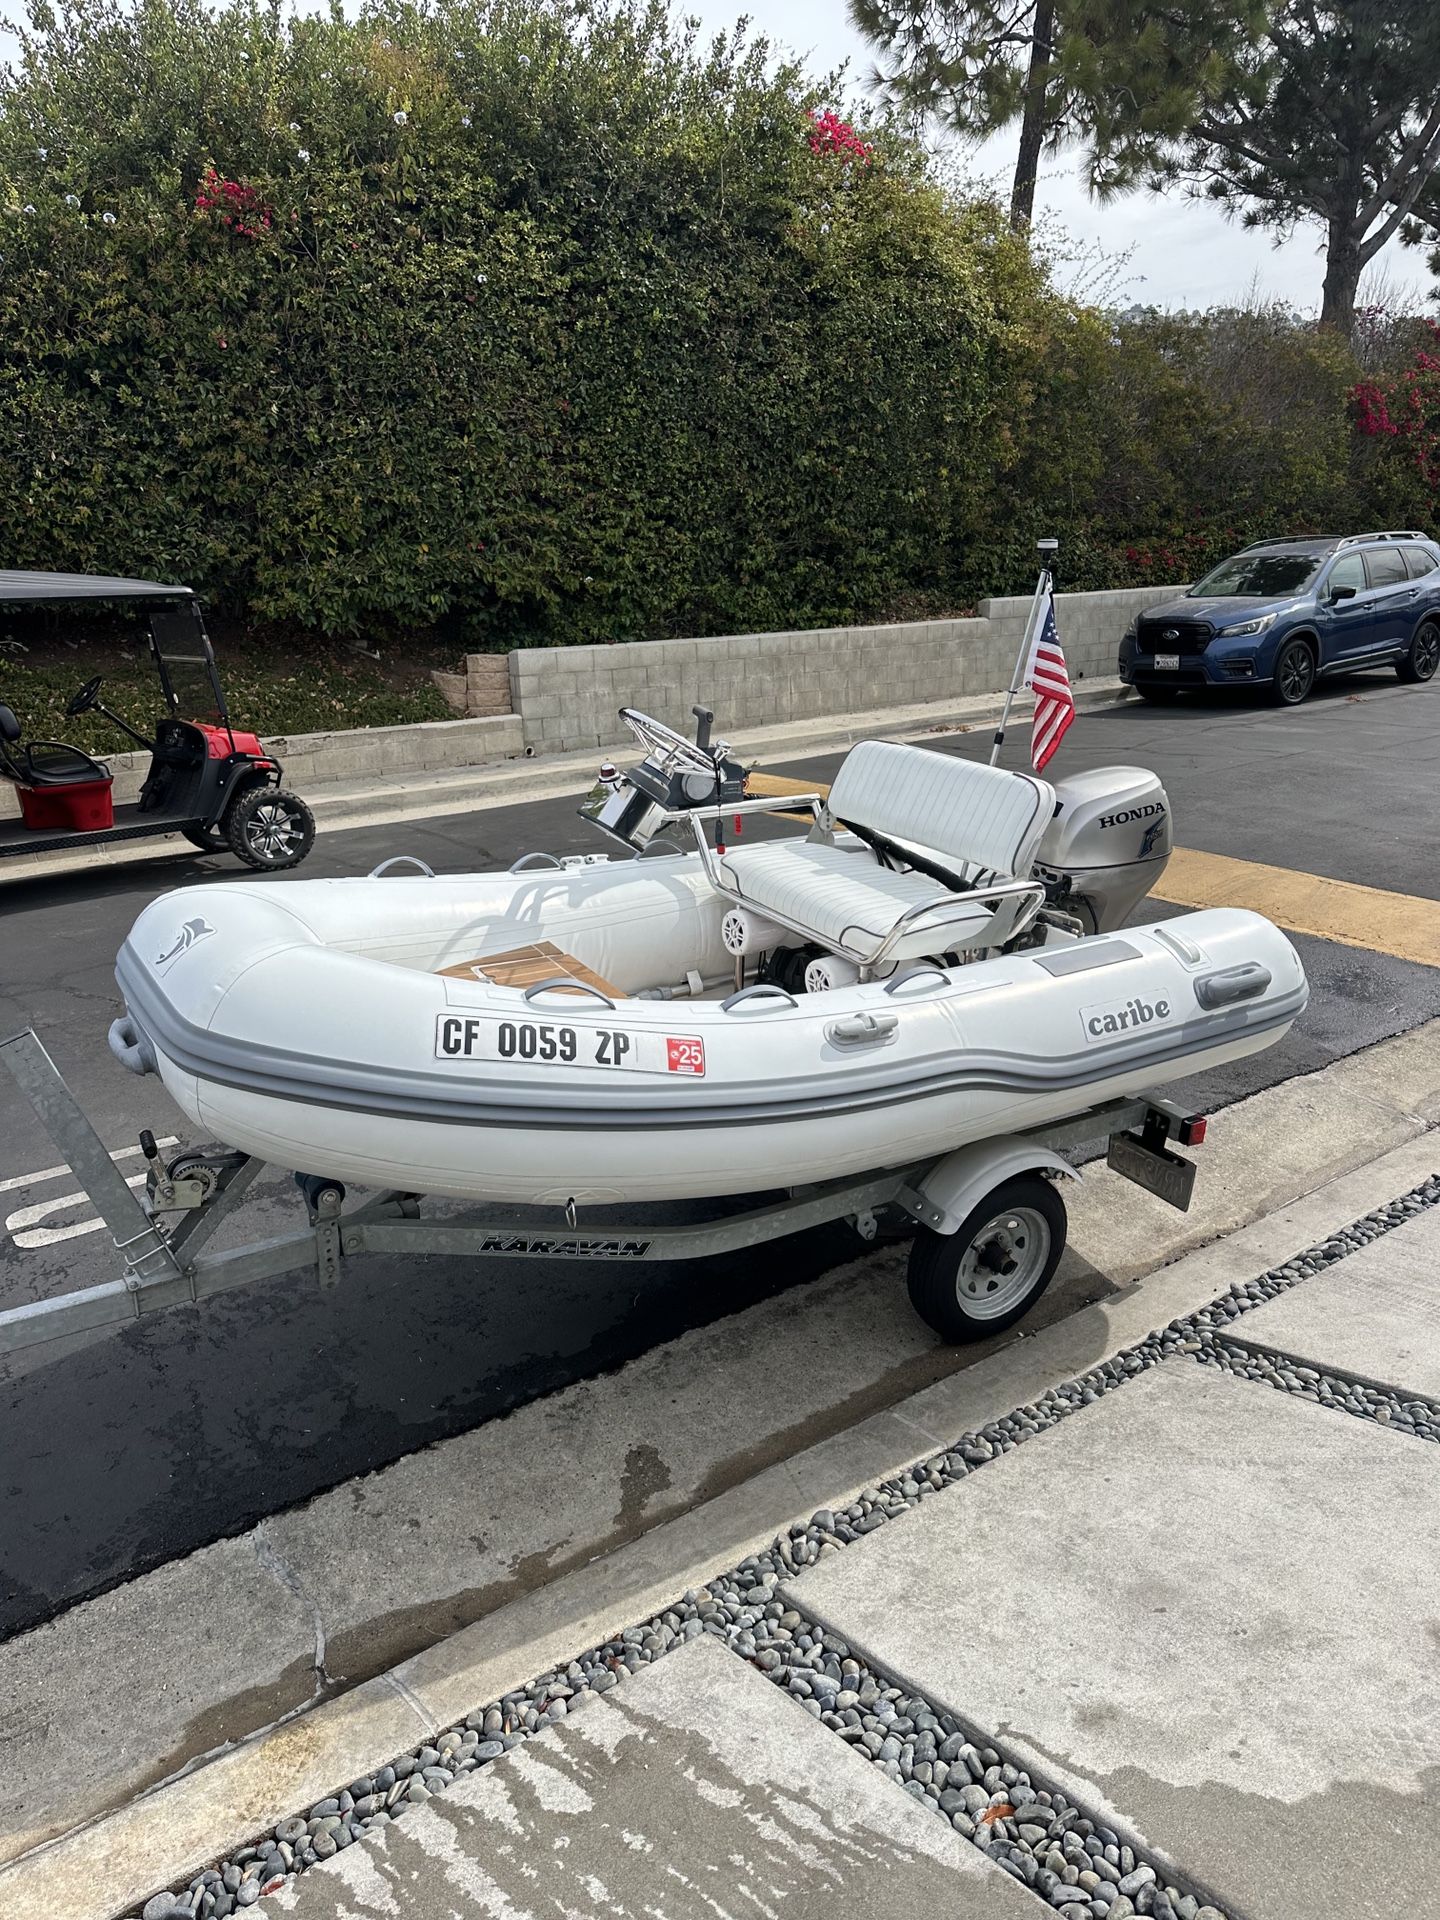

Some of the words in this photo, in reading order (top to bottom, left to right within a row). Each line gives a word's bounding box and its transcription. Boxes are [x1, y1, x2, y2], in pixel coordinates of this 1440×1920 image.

[1098, 802, 1166, 829] HONDA
[1088, 999, 1170, 1036] caribe
[442, 1019, 480, 1055] CF
[498, 1023, 577, 1062] 0059
[595, 1031, 630, 1065] ZP
[679, 1045, 702, 1065] 25
[479, 1235, 655, 1257] KARAVAN
